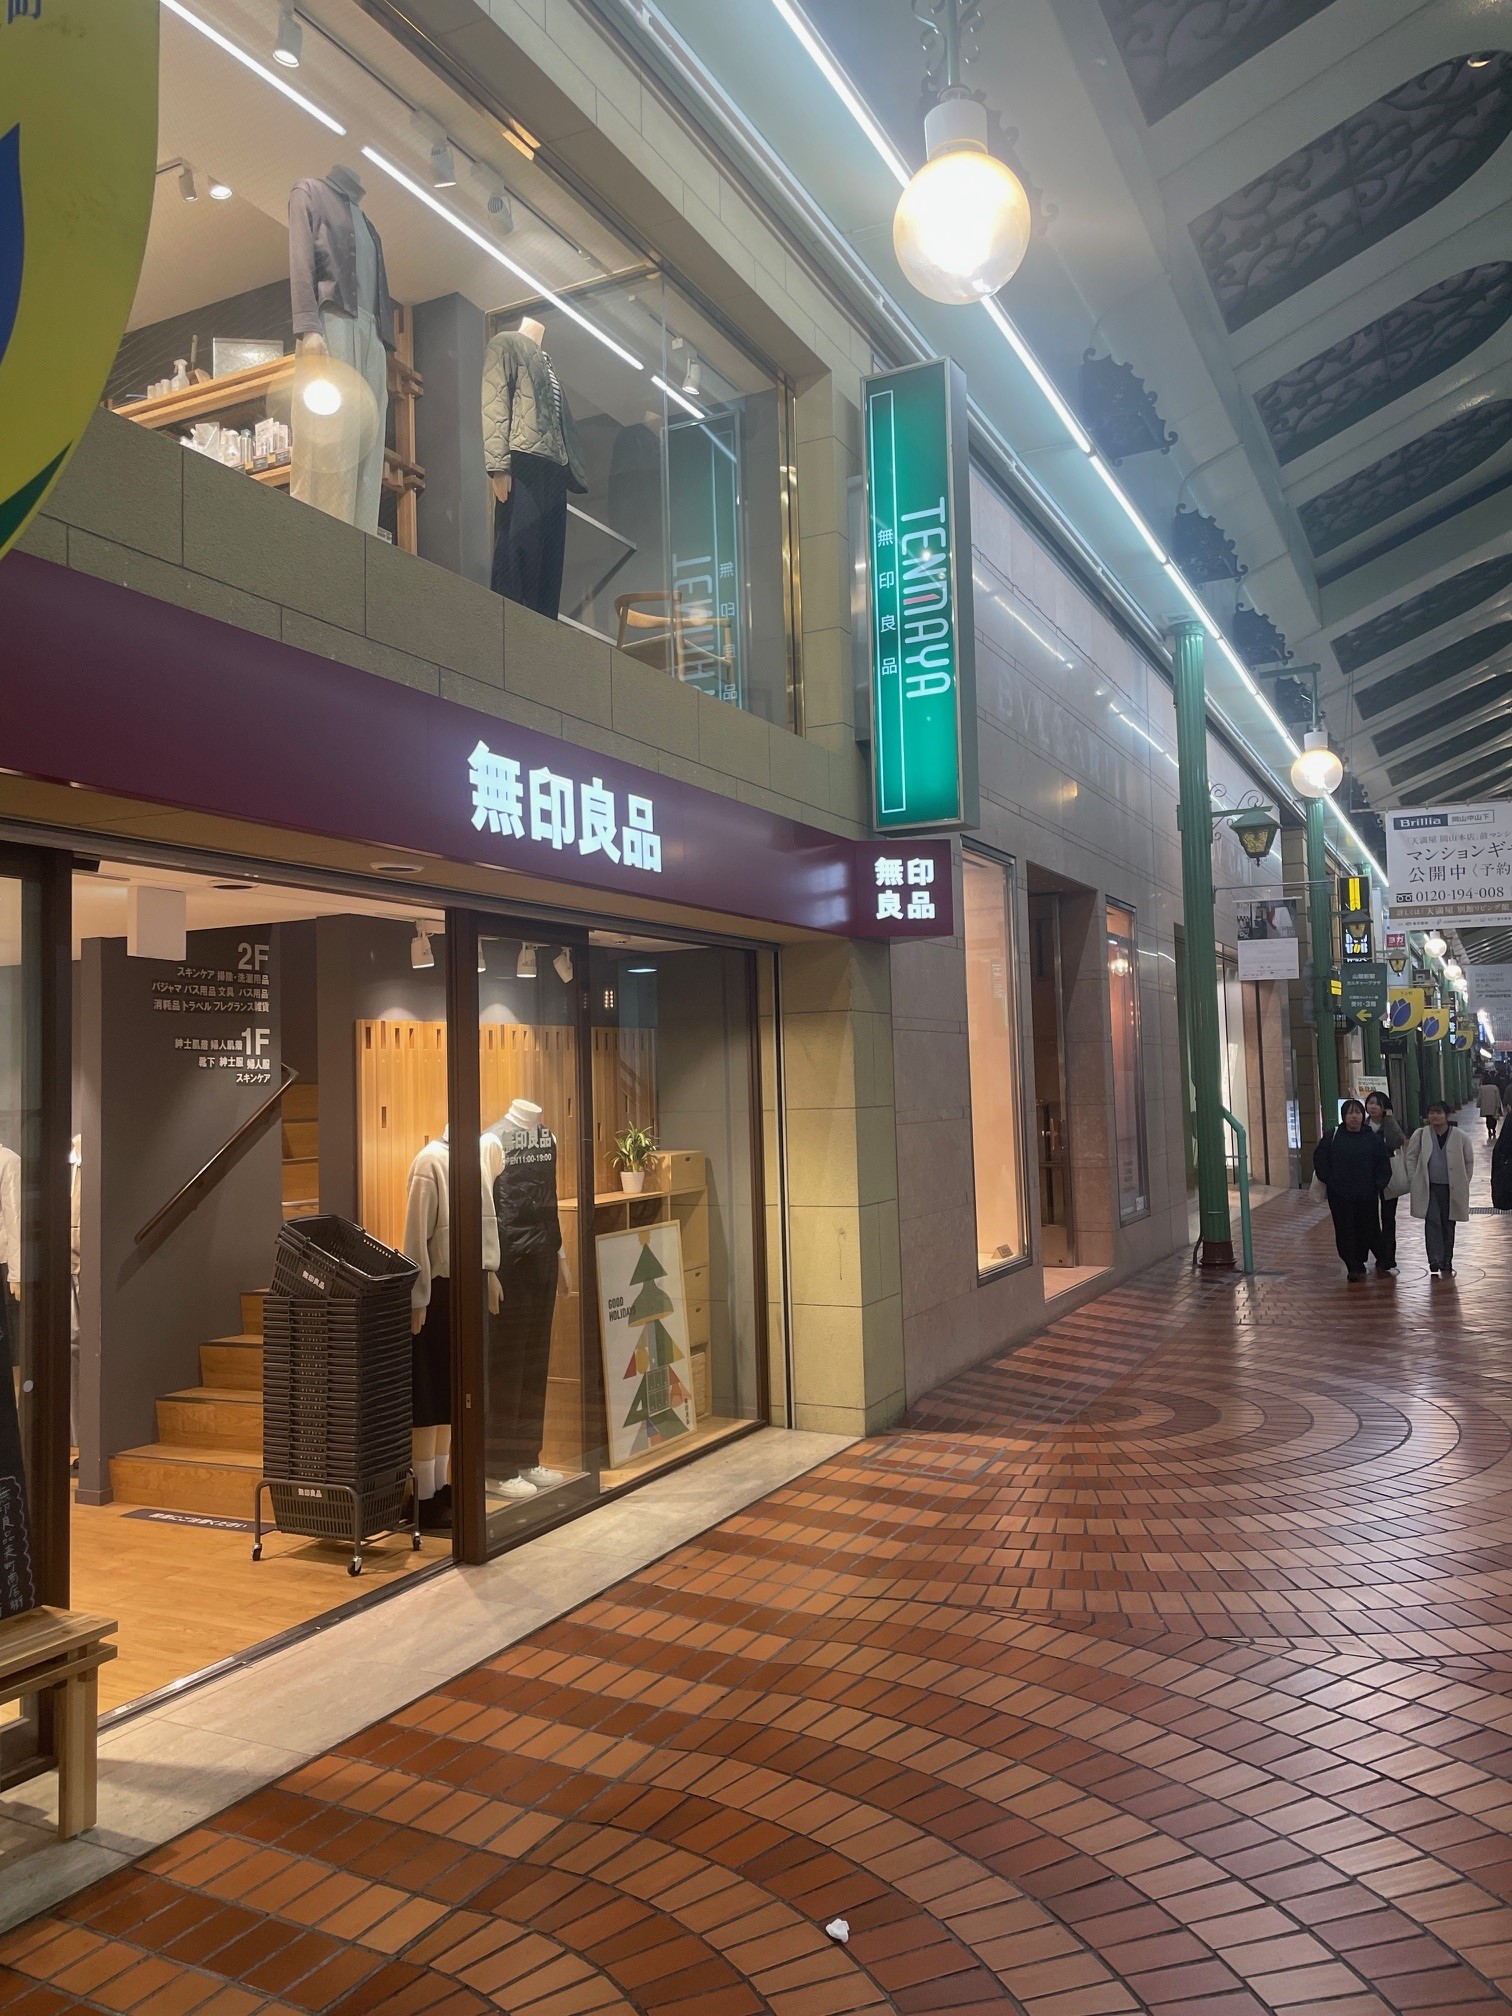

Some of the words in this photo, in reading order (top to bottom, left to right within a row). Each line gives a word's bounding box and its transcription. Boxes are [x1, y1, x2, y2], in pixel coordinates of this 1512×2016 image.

[877, 529, 898, 675] 無印良品
[901, 496, 951, 699] TENMAYA
[467, 739, 662, 873] 無印良品
[1400, 817, 1442, 828] Brillia
[1452, 813, 1490, 823] 岡山中山下
[874, 856, 935, 886] 無印
[1416, 886, 1504, 903] 0120-194-008
[876, 889, 936, 920] 良品
[1388, 935, 1404, 944] ヨガ
[237, 942, 270, 971] 2F
[177, 966, 215, 980] スキンケア
[184, 984, 217, 997] バス用品
[218, 986, 235, 998] 文具
[239, 988, 269, 999] バス用品
[153, 998, 180, 1011] 消耗品
[182, 1000, 212, 1012] トラベル
[241, 1027, 271, 1056] 1F
[198, 1056, 216, 1068] 靴下
[219, 1056, 244, 1068] 紳士服
[236, 1073, 271, 1084] スキンケア
[502, 1128, 552, 1154] 無印良品
[608, 1296, 624, 1310] GOOD
